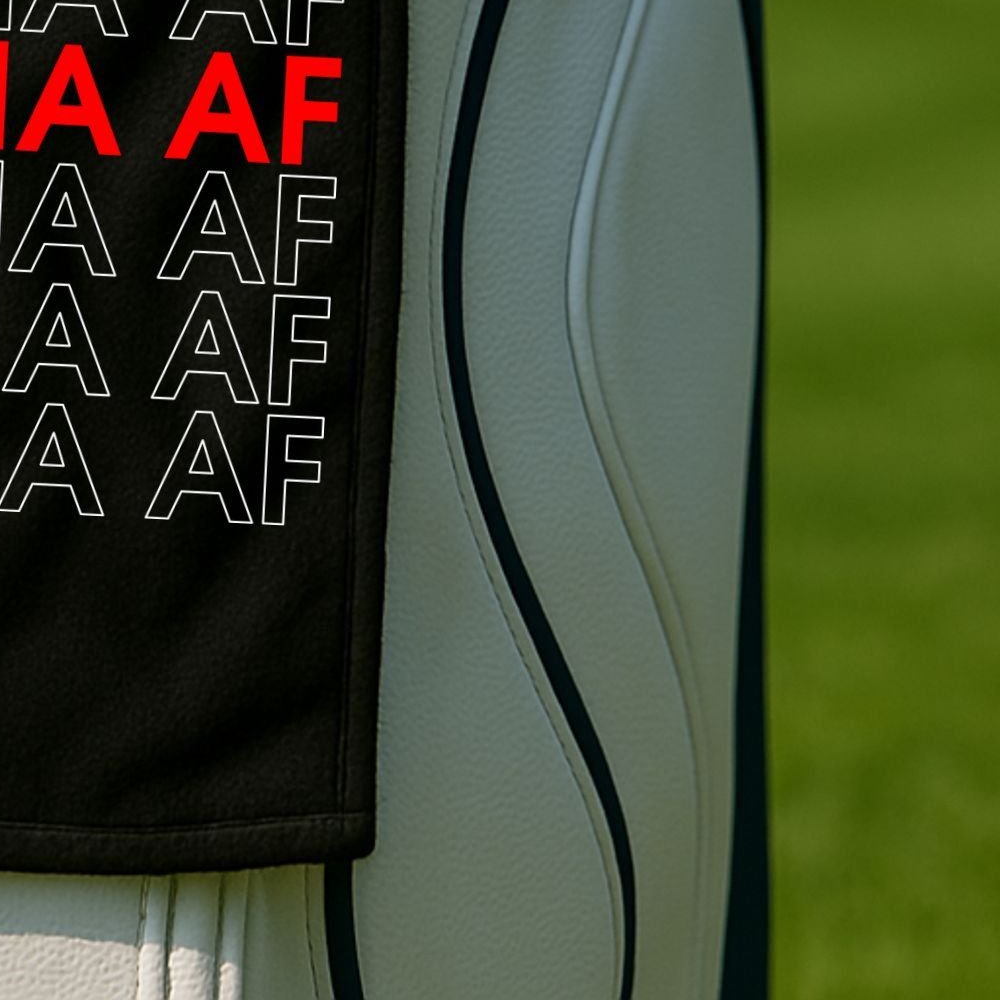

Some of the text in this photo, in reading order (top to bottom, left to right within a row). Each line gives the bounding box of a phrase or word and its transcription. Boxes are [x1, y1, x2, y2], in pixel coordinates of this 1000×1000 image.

[165, 52, 341, 164] AF
[157, 171, 337, 286] AF
[151, 291, 331, 406] AF
[145, 410, 325, 525] AF
